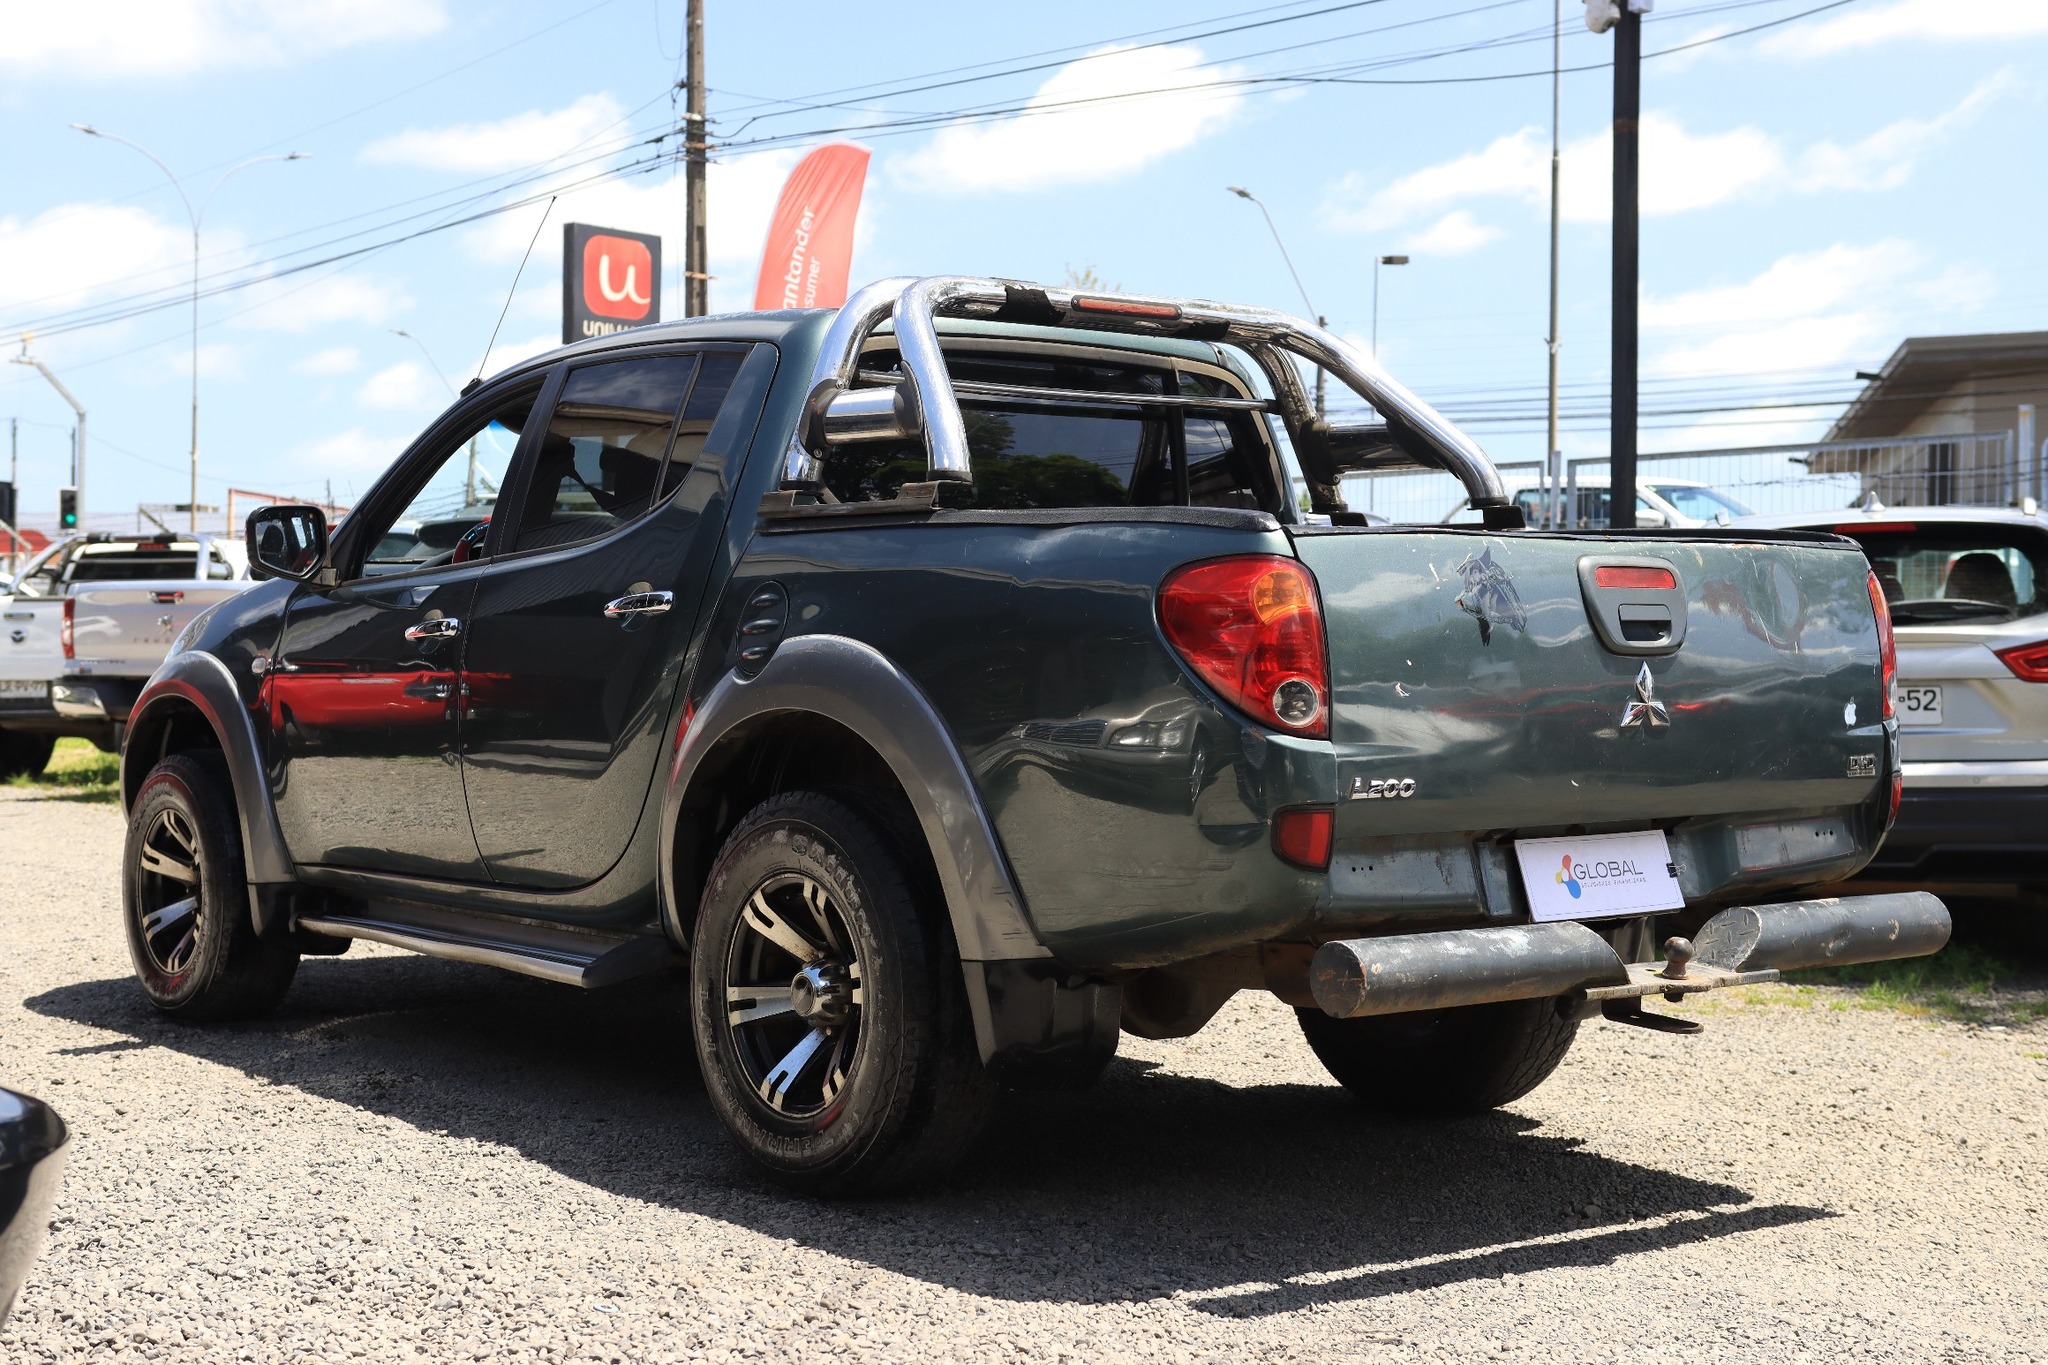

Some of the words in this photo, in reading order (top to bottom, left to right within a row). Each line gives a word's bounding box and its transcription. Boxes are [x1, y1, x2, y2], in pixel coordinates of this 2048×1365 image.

[782, 205, 816, 309] antander
[804, 257, 821, 309] sumer
[1350, 777, 1416, 800] L200
[1574, 859, 1644, 880] GLOBAL
